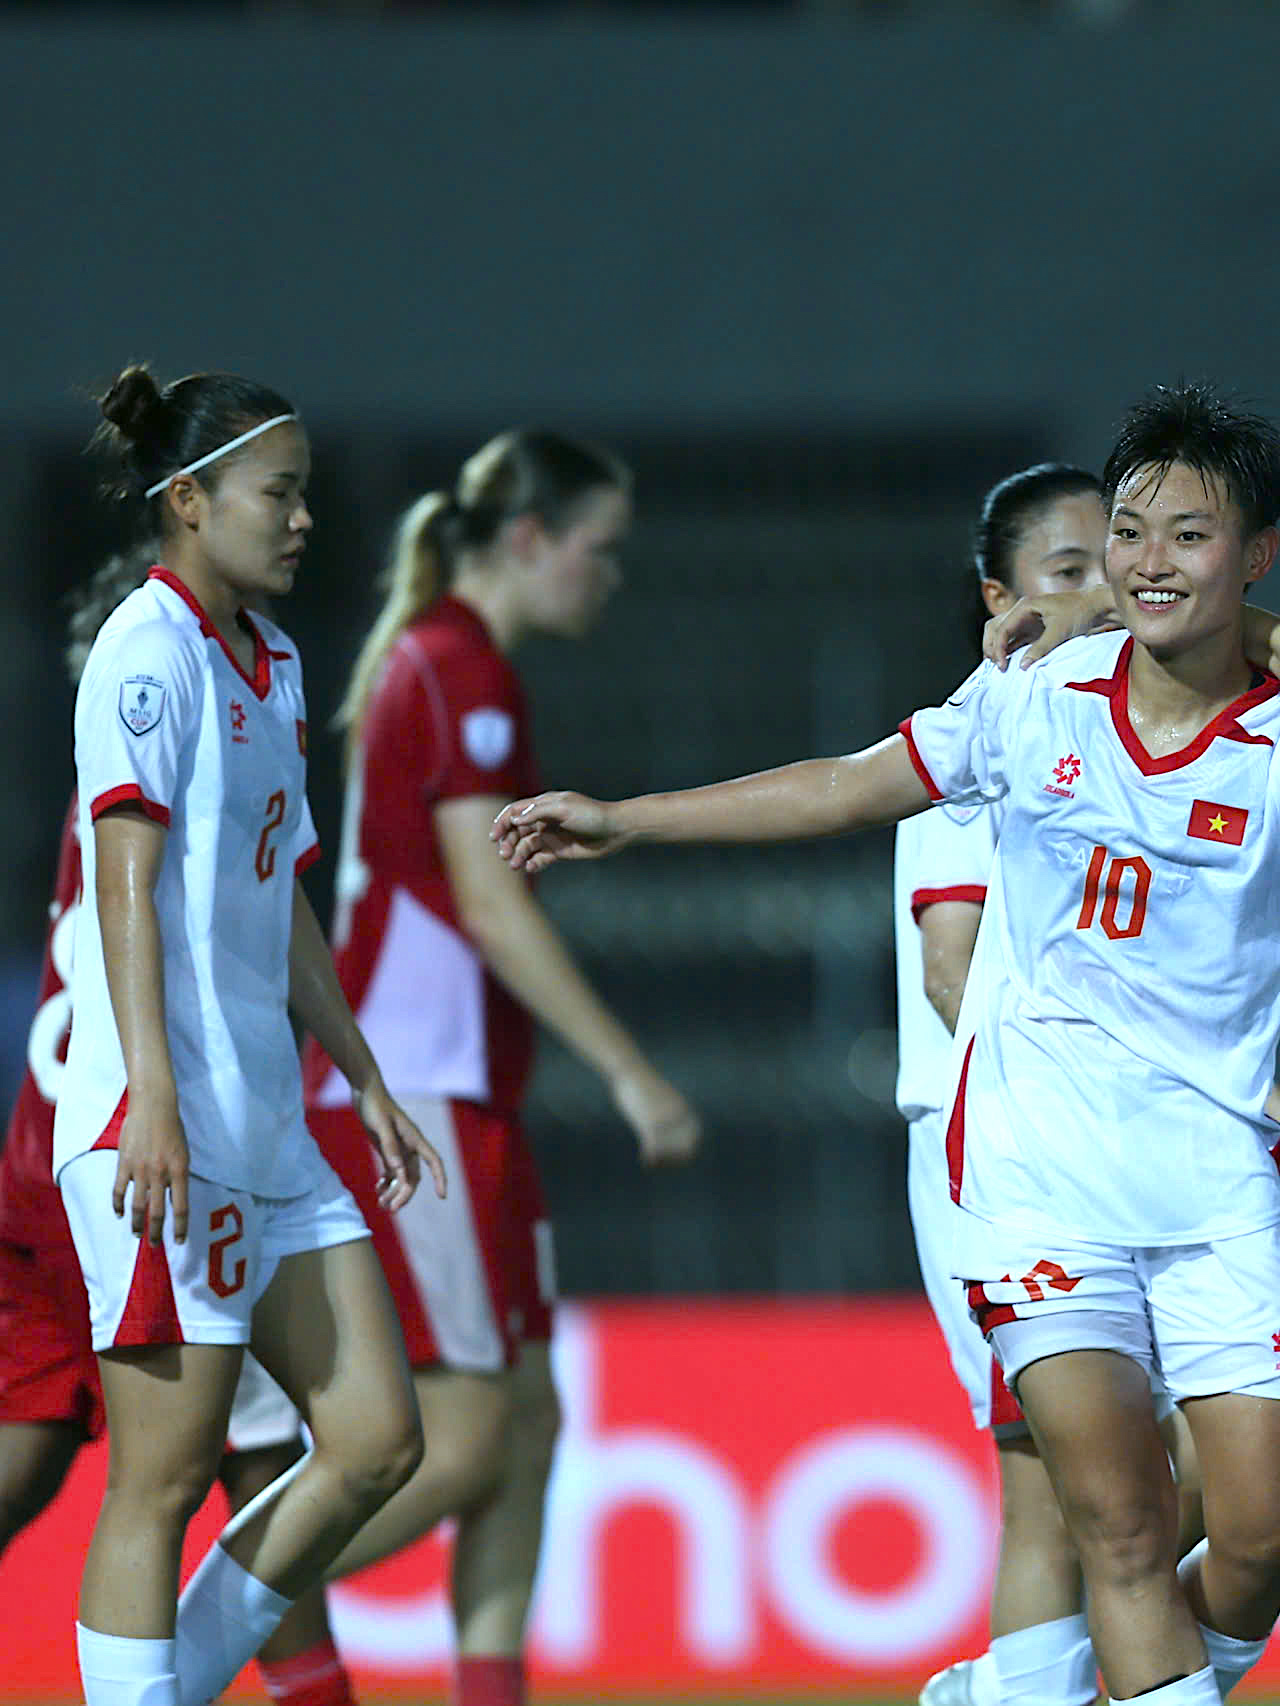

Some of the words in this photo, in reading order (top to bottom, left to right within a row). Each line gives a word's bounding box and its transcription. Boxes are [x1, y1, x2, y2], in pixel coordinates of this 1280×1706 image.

[255, 789, 286, 884] 2
[1076, 846, 1153, 941] 10
[208, 1201, 247, 1299] 2
